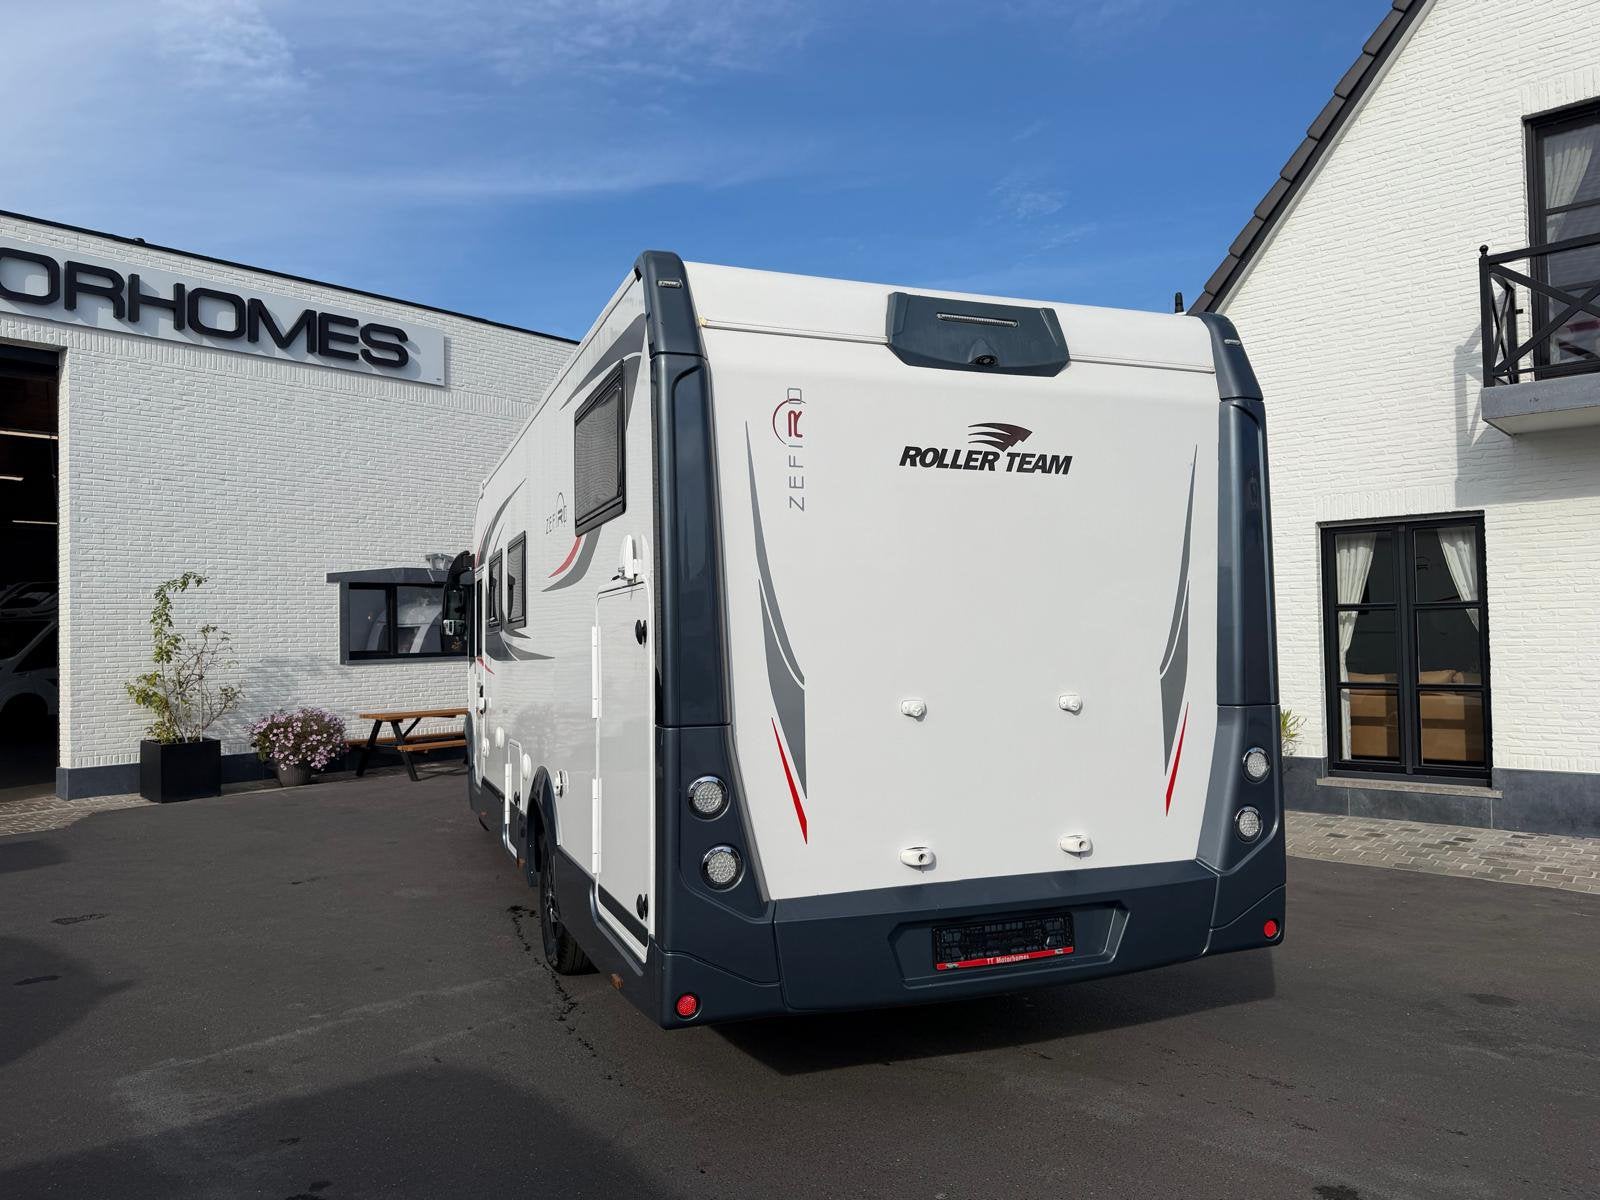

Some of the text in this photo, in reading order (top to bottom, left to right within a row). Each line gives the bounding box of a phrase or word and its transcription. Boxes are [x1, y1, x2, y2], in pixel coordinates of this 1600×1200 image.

[784, 387, 806, 512] ZEFIRO
[899, 446, 1073, 475] ROLLER TEAM
[986, 957, 994, 965] TT
